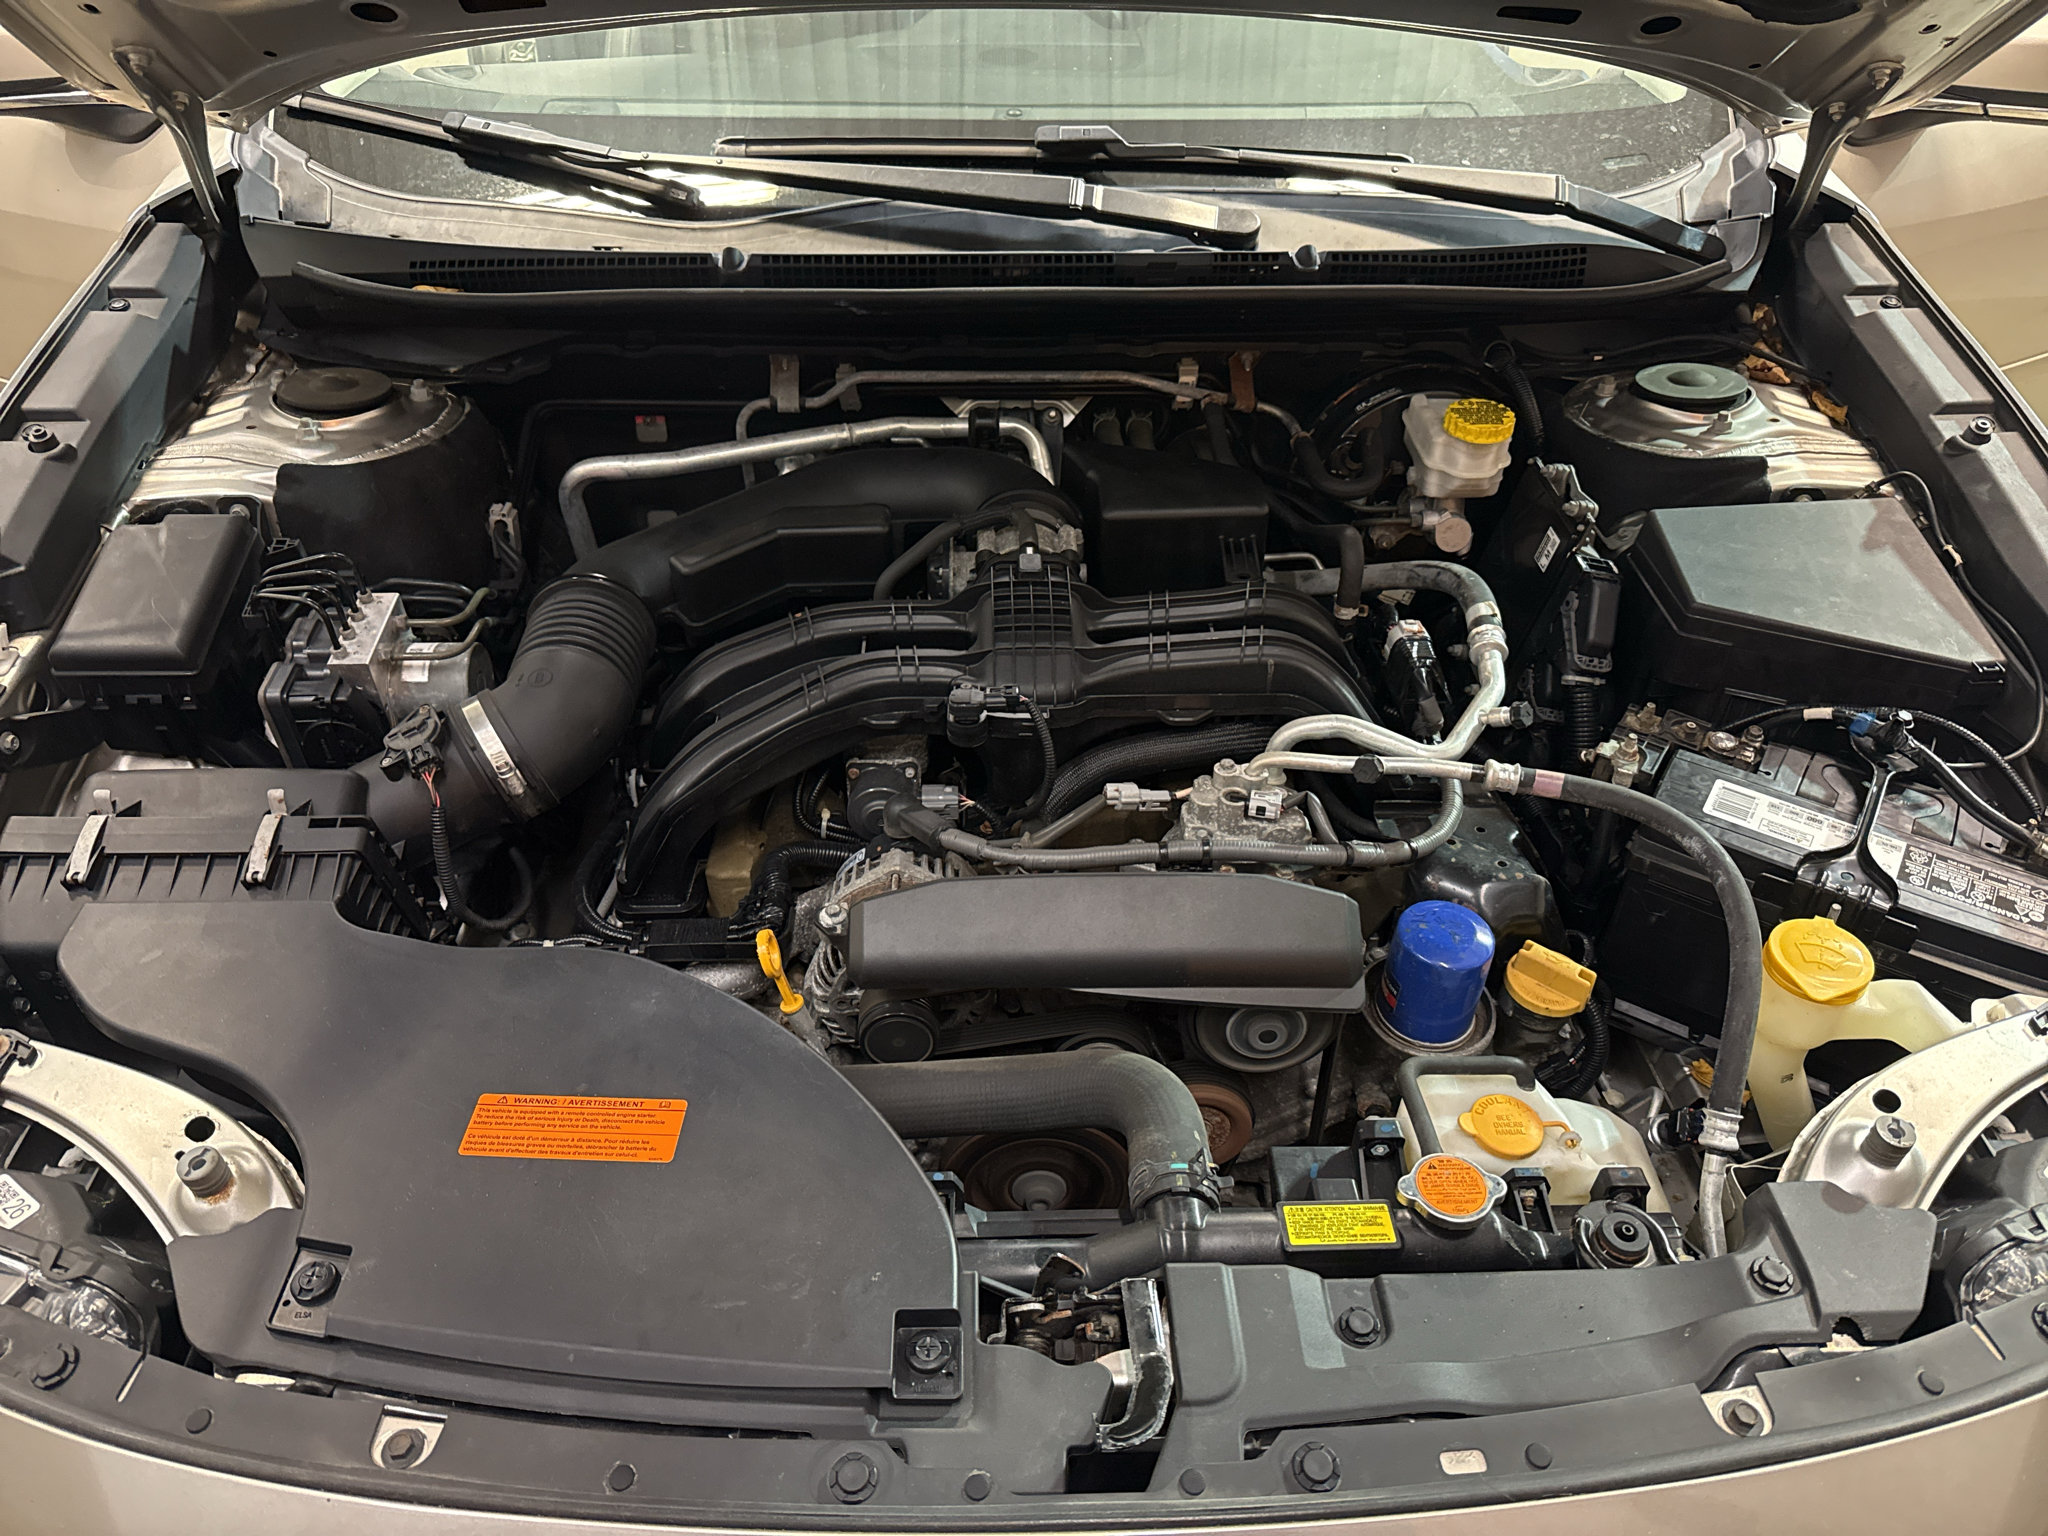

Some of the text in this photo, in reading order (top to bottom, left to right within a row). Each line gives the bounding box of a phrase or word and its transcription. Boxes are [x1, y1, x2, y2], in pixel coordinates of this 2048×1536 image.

[1930, 884, 2021, 921] DANGER/POISON
[568, 1099, 646, 1108] AVERTISSEMENT
[2, 1198, 32, 1219] 26
